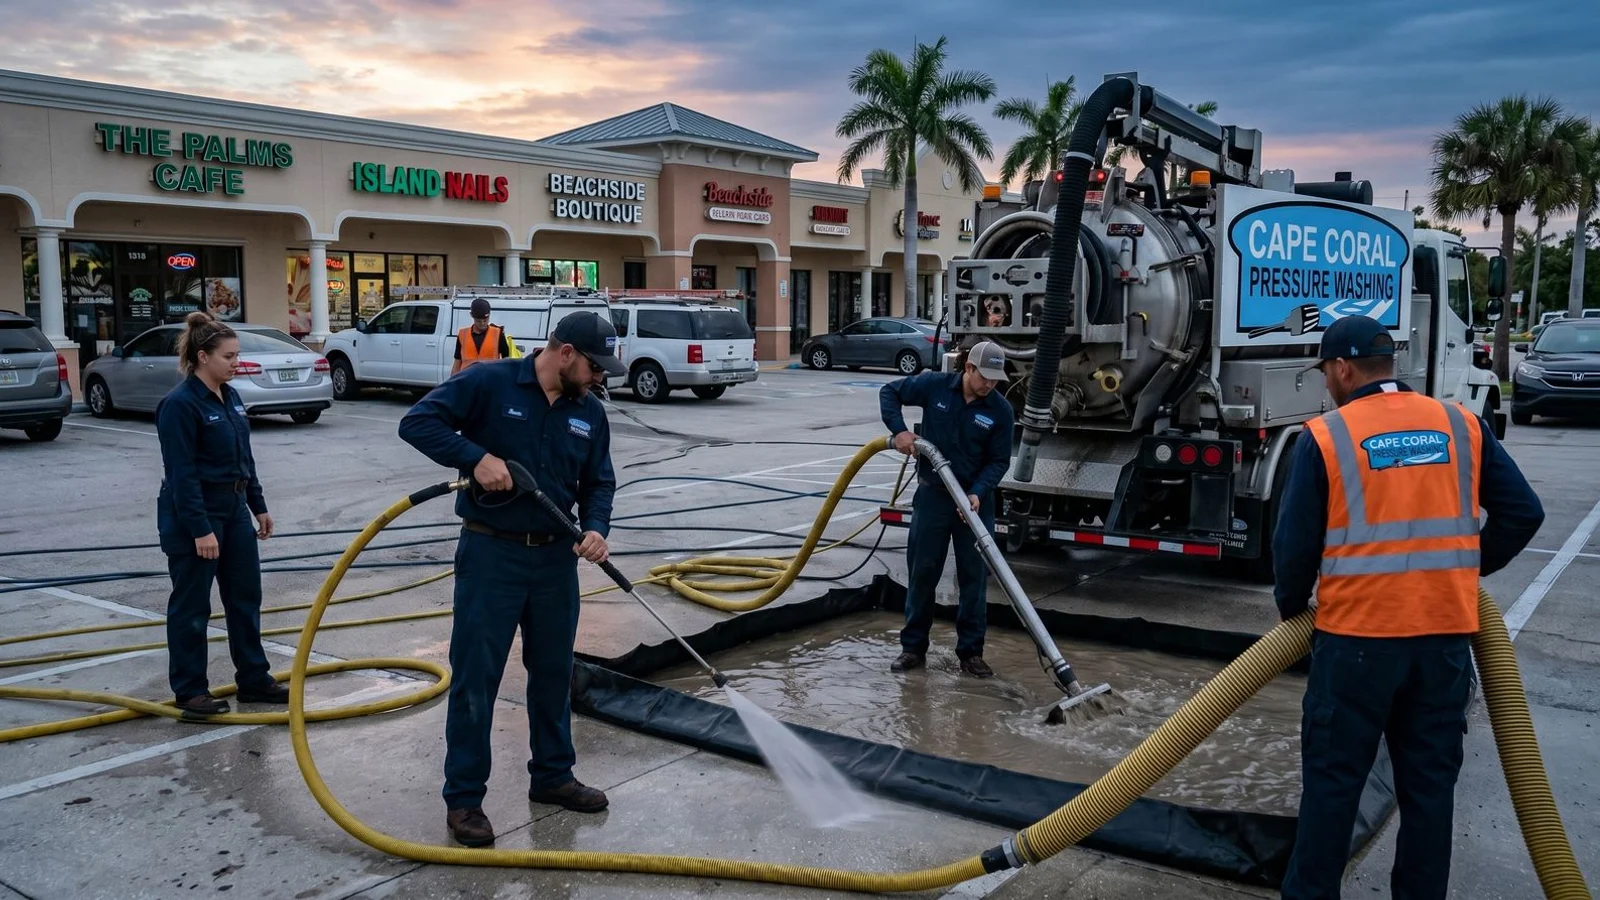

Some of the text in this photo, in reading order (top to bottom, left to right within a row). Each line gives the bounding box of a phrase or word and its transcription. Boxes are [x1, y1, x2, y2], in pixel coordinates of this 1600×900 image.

[96, 122, 294, 169] THE PALMS
[153, 162, 245, 196] CAFE
[353, 162, 509, 203] ISLAND NAILS
[549, 173, 647, 201] BEACHSIDE
[705, 181, 774, 208] Beachside
[555, 198, 643, 224] BOUTIQUE
[128, 252, 146, 260] 1318
[1249, 219, 1396, 268] CAPE CORAL
[167, 255, 196, 268] OPEN
[1250, 266, 1394, 300] PRESSURE WASHING
[1369, 434, 1443, 449] CAPE CORAL
[1372, 443, 1444, 459] PRESSURE WASHING
